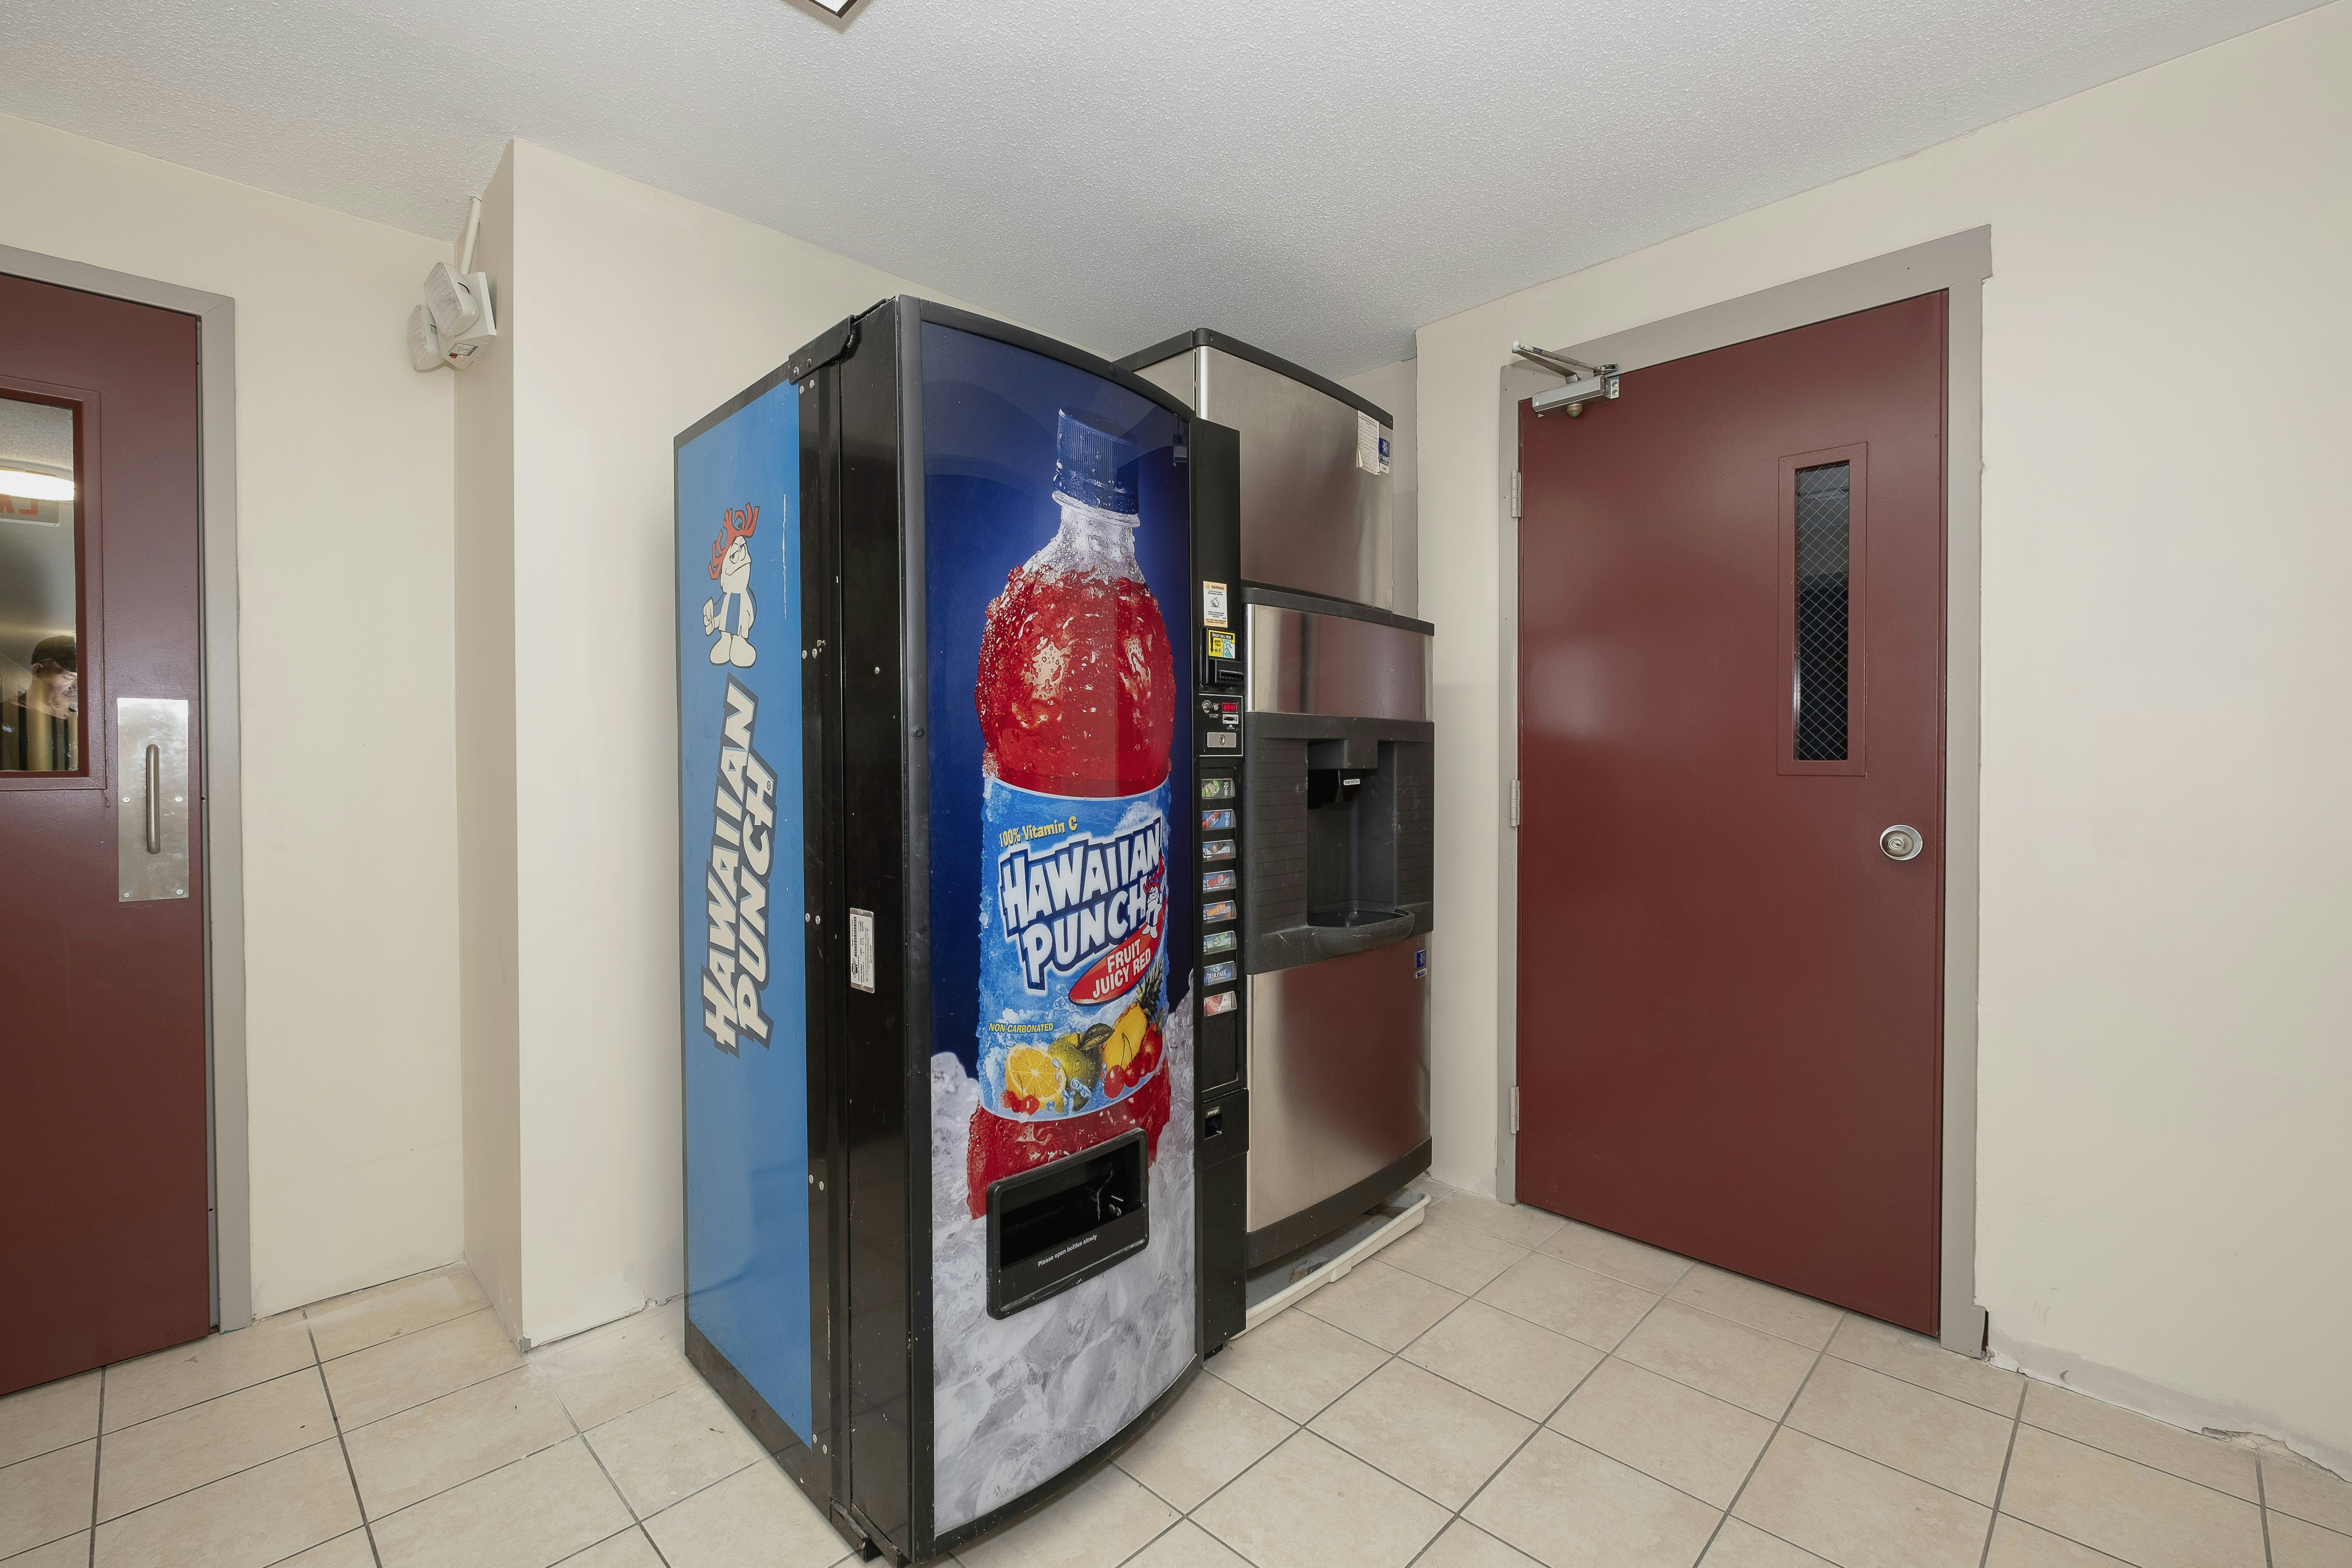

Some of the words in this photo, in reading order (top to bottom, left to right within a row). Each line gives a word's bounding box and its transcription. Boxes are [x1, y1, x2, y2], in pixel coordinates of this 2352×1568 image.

[999, 827, 1021, 848] 100%
[1022, 819, 1065, 840] Vitamin
[1069, 816, 1078, 831] C
[703, 681, 756, 1050] HAWAIIAN
[1002, 822, 1163, 931] HAWAIIAN
[735, 752, 776, 1040] PUNCH
[1022, 876, 1147, 985] PUNCH
[1092, 964, 1131, 998] JUICY
[1132, 949, 1152, 978] RED
[1107, 938, 1141, 974] FRUIT
[1217, 969, 1227, 978] PARK
[989, 1023, 1053, 1033] NON-CARBONATED
[1038, 1256, 1054, 1267] Please
[1054, 1249, 1066, 1258] open
[1067, 1241, 1082, 1252] bottles
[1083, 1234, 1097, 1244] slowly
